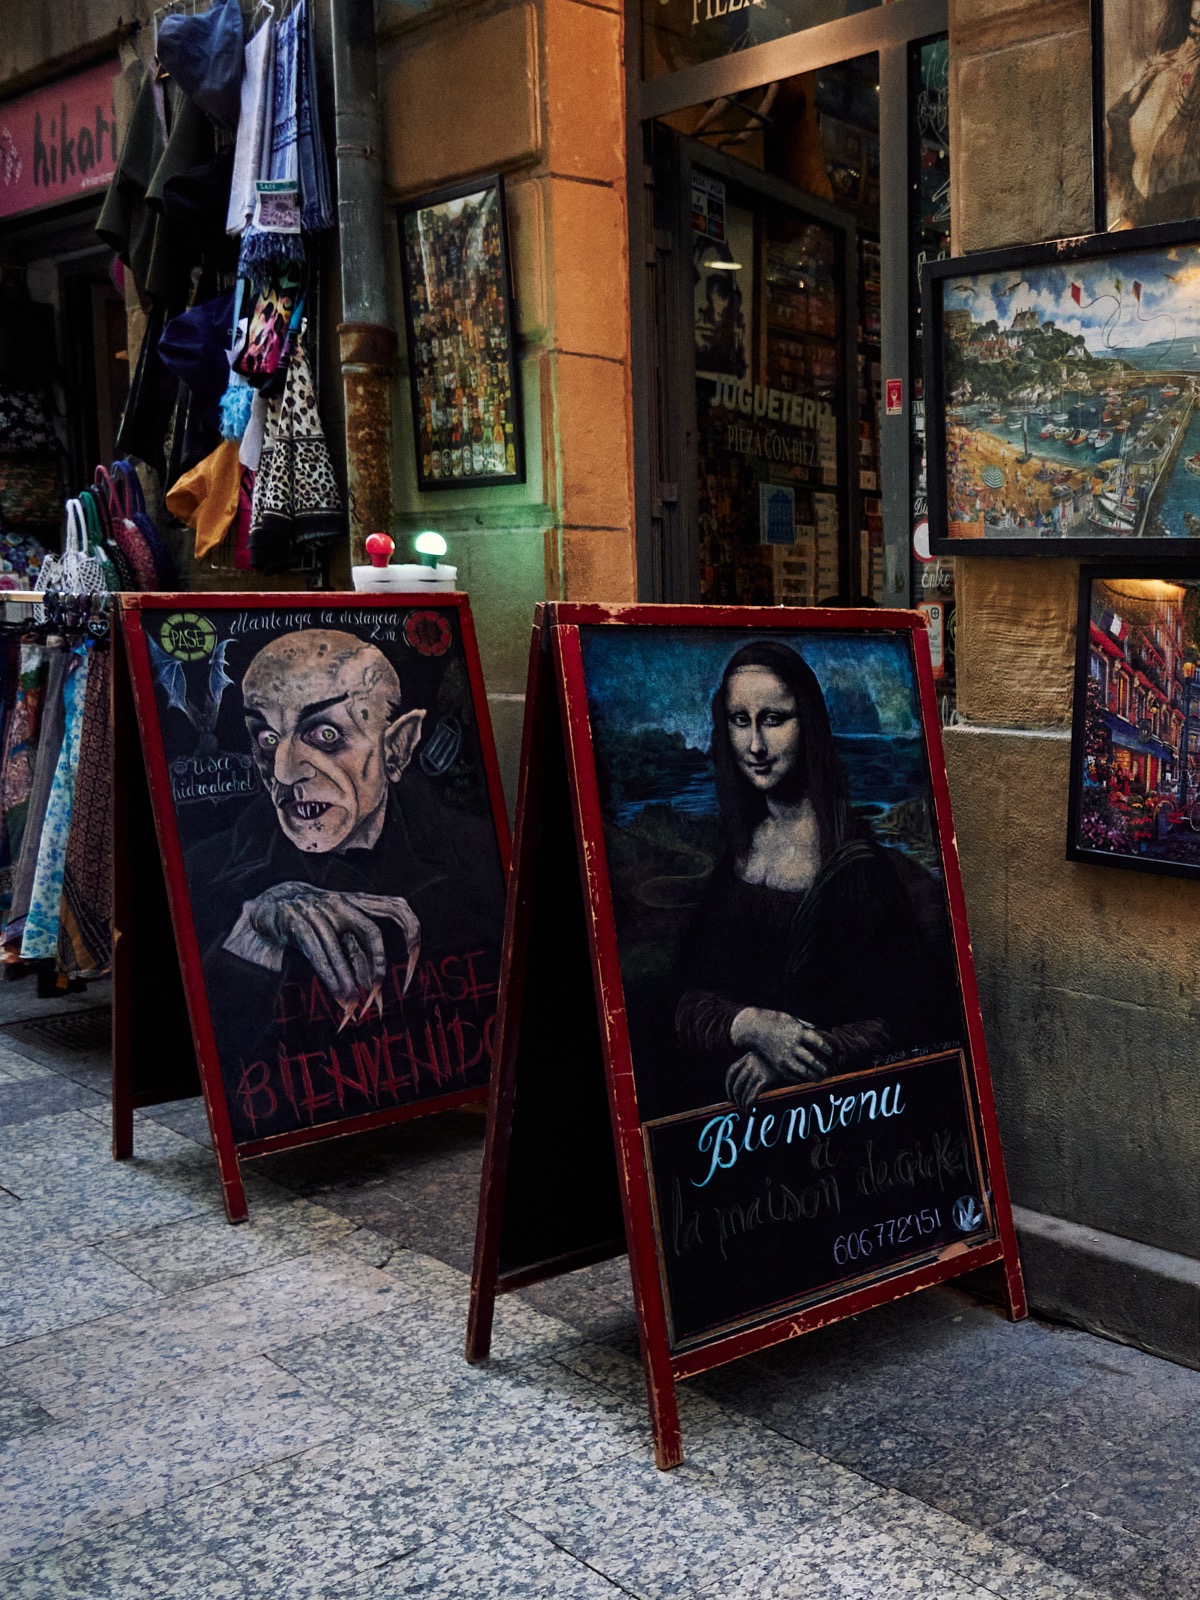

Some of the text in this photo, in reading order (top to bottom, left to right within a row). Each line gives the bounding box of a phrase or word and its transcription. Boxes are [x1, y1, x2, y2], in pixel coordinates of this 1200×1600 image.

[33, 101, 118, 187] hikari
[340, 609, 400, 627] distancia
[170, 628, 205, 650] PASE
[173, 770, 257, 801] hidroalcohol
[690, 1081, 906, 1188] Bienvenu
